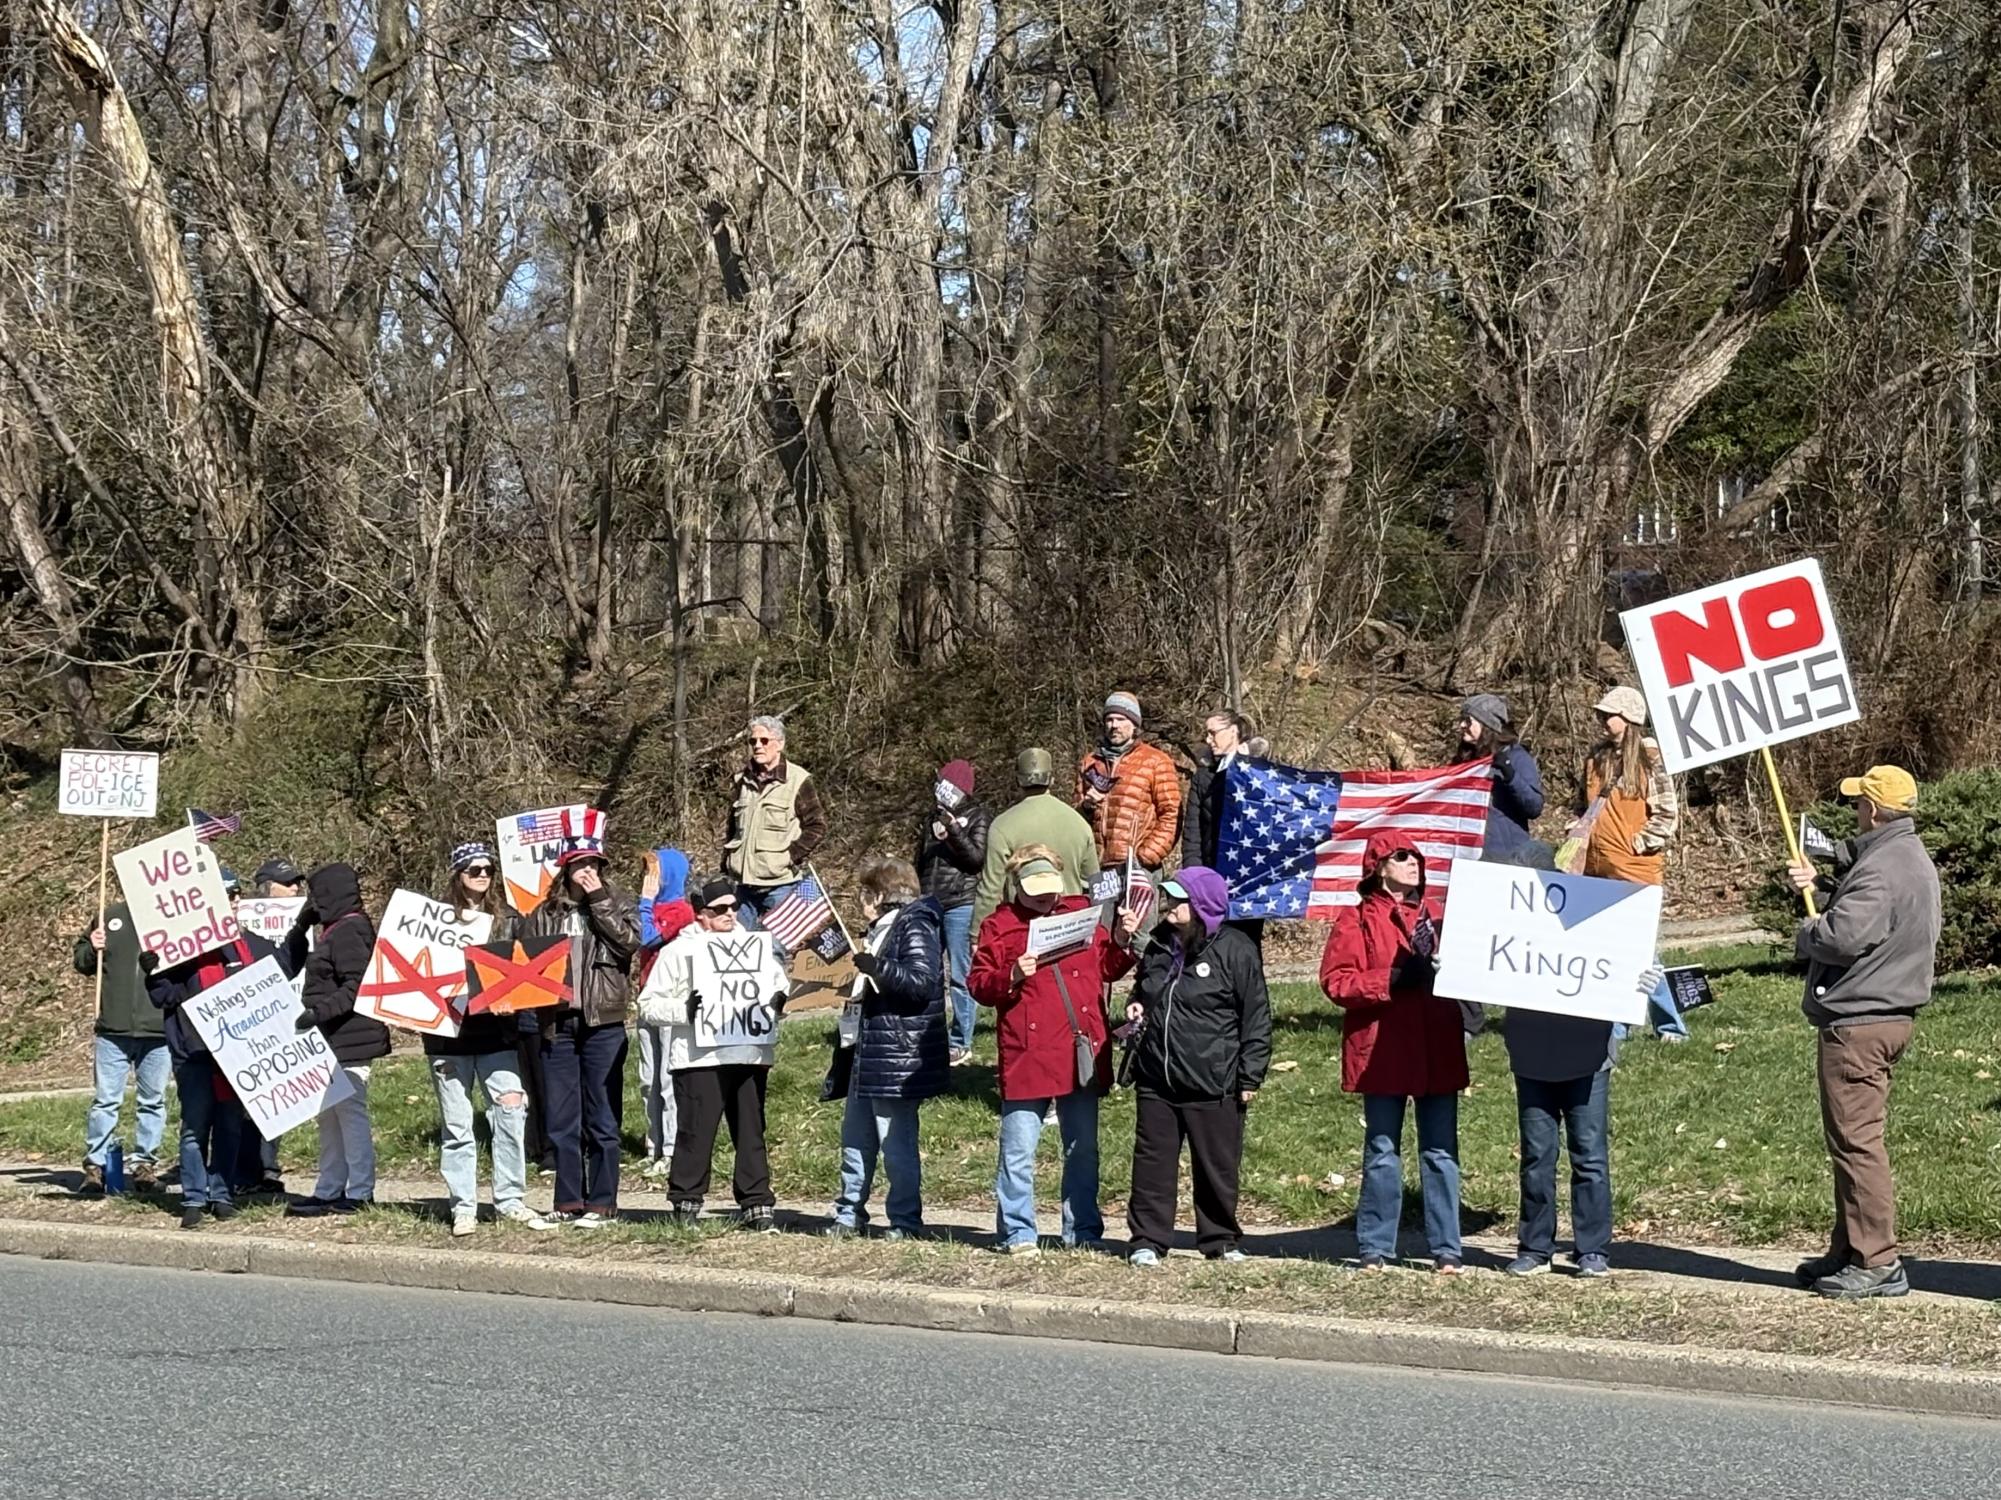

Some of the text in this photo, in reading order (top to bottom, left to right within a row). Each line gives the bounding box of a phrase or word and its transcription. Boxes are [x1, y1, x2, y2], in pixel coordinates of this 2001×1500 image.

[1650, 576, 1824, 689] NO
[1667, 650, 1851, 759] KINGS
[68, 753, 149, 773] SECRET
[66, 788, 106, 805] OUT
[120, 791, 147, 807] NJ
[138, 849, 192, 887] We
[155, 886, 205, 918] the
[422, 902, 457, 925] NO
[1510, 880, 1567, 914] NO
[143, 906, 240, 964] People
[252, 918, 261, 930] IS
[397, 915, 474, 950] KINGS
[195, 992, 247, 1022] Nothing
[256, 972, 282, 992] more
[720, 980, 760, 1002] NO
[212, 999, 288, 1053] American
[701, 1002, 772, 1037] KINGS
[236, 1031, 326, 1092] OPPOSING
[247, 1034, 281, 1058] than
[248, 1060, 334, 1120] TYRANNY
